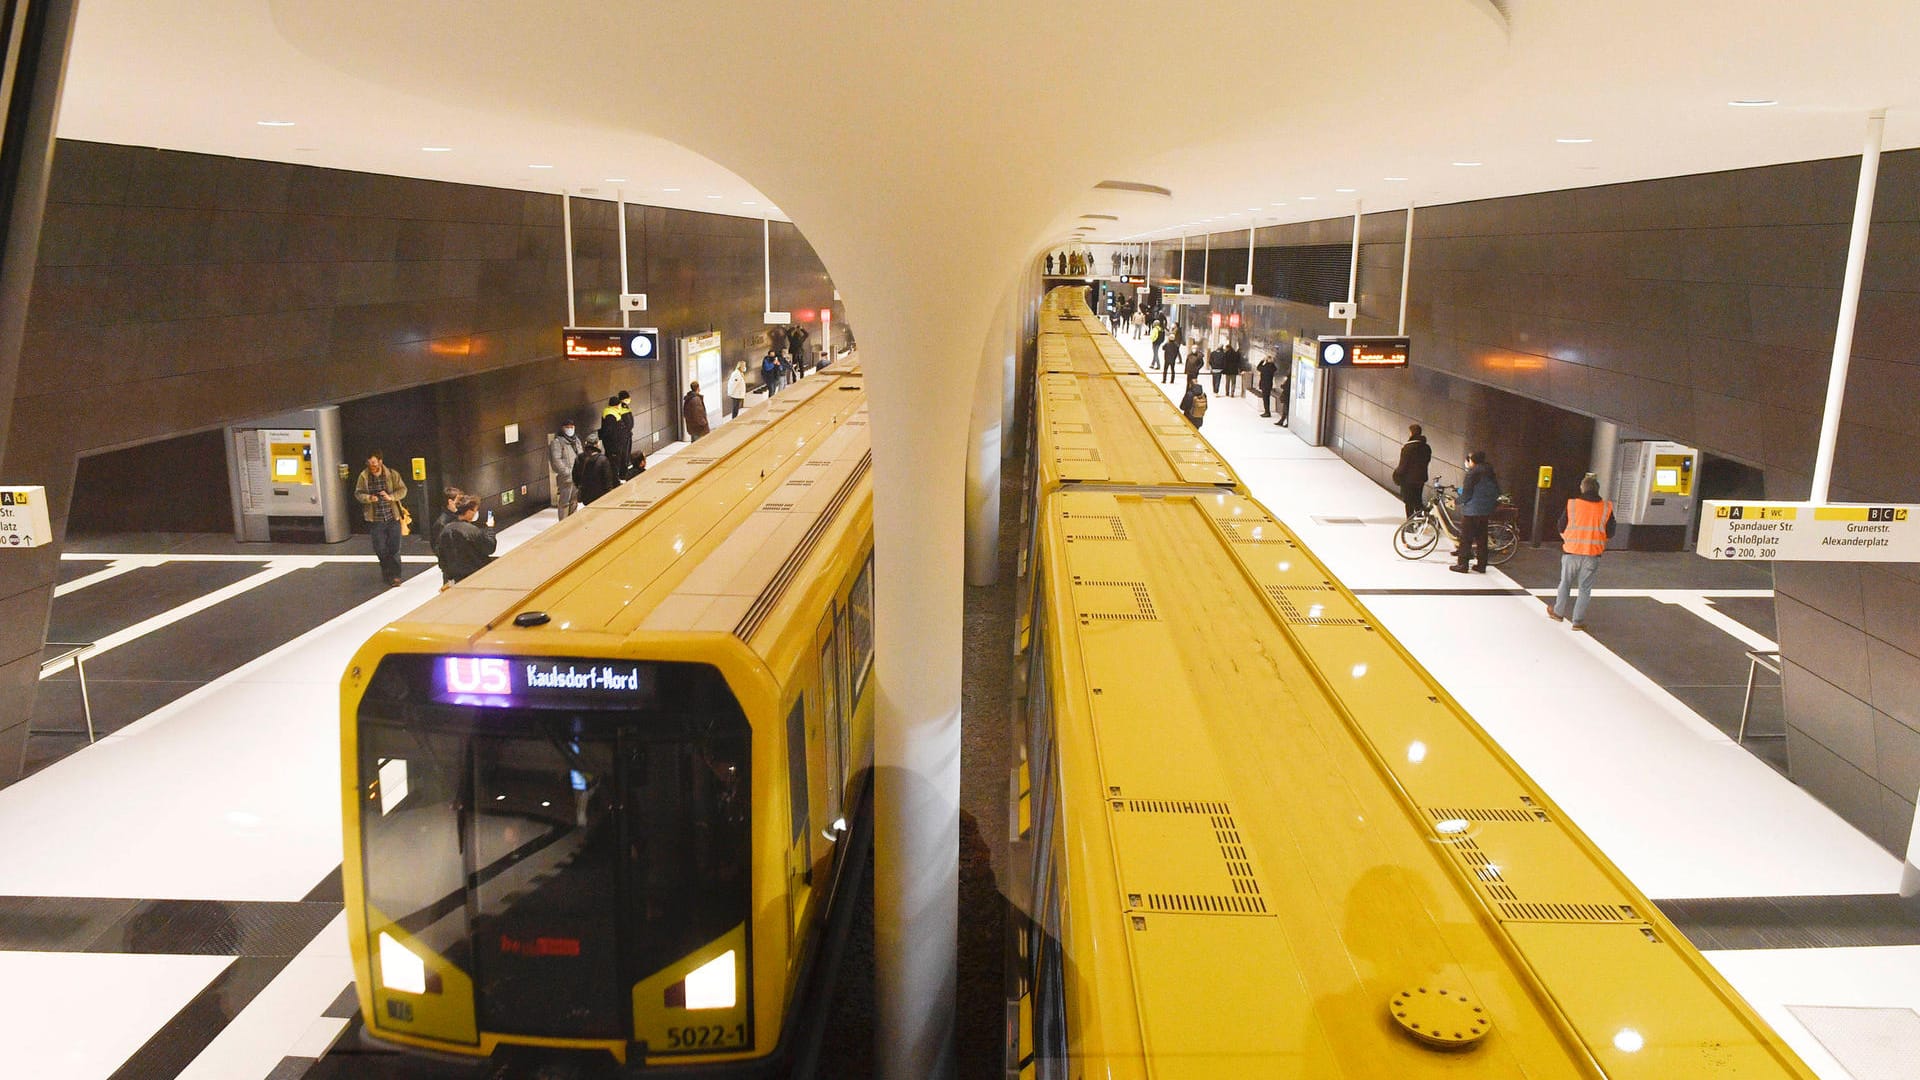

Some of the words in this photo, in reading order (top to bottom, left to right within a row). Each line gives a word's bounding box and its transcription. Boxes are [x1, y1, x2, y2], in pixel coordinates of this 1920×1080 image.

[4, 493, 12, 503] A
[1732, 507, 1740, 517] A
[1771, 509, 1783, 517] WC
[1871, 509, 1878, 519] B
[1883, 509, 1891, 519] C
[1729, 521, 1777, 532] Spandauer
[1780, 521, 1794, 531] Str.
[1846, 523, 1890, 533] Grunerstr.
[1727, 534, 1779, 546] Schloßplatz
[1822, 536, 1889, 548] Alexanderplatz
[1738, 548, 1756, 558] 200,
[1760, 548, 1776, 557] 300
[449, 656, 507, 691] U5
[526, 664, 638, 690] Kaulsdorf-Nord
[667, 1024, 745, 1048] 5022-1
